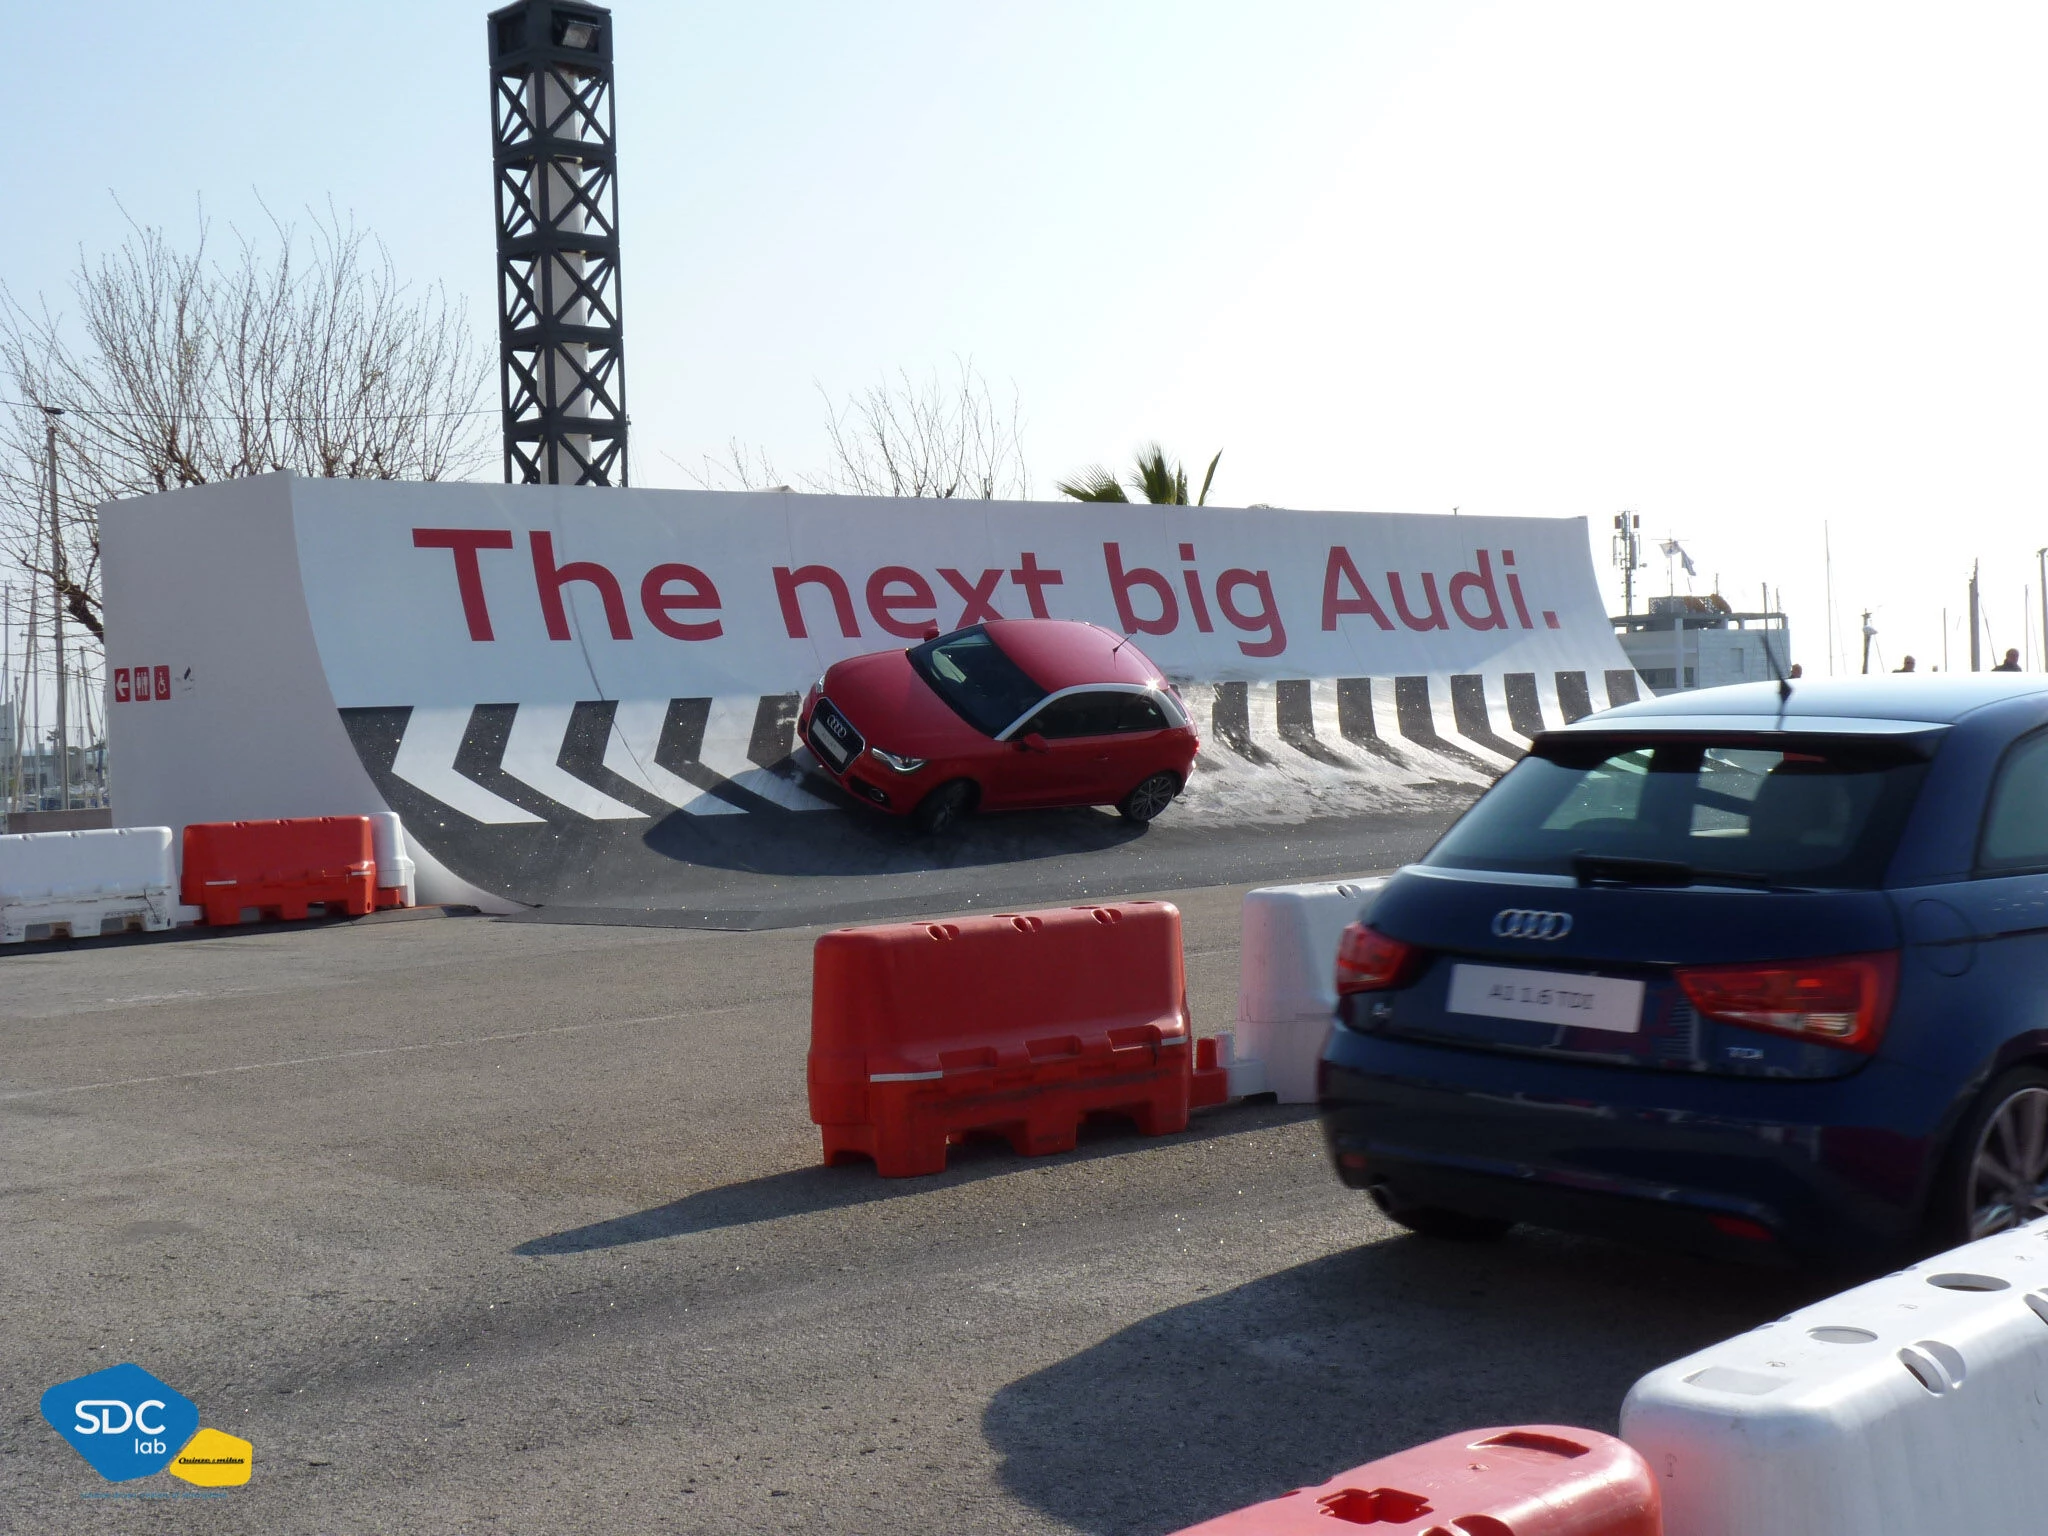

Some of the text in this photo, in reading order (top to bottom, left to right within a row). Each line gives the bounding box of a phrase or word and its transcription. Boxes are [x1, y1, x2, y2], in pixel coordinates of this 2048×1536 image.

[412, 529, 1560, 658] The next big Audi.
